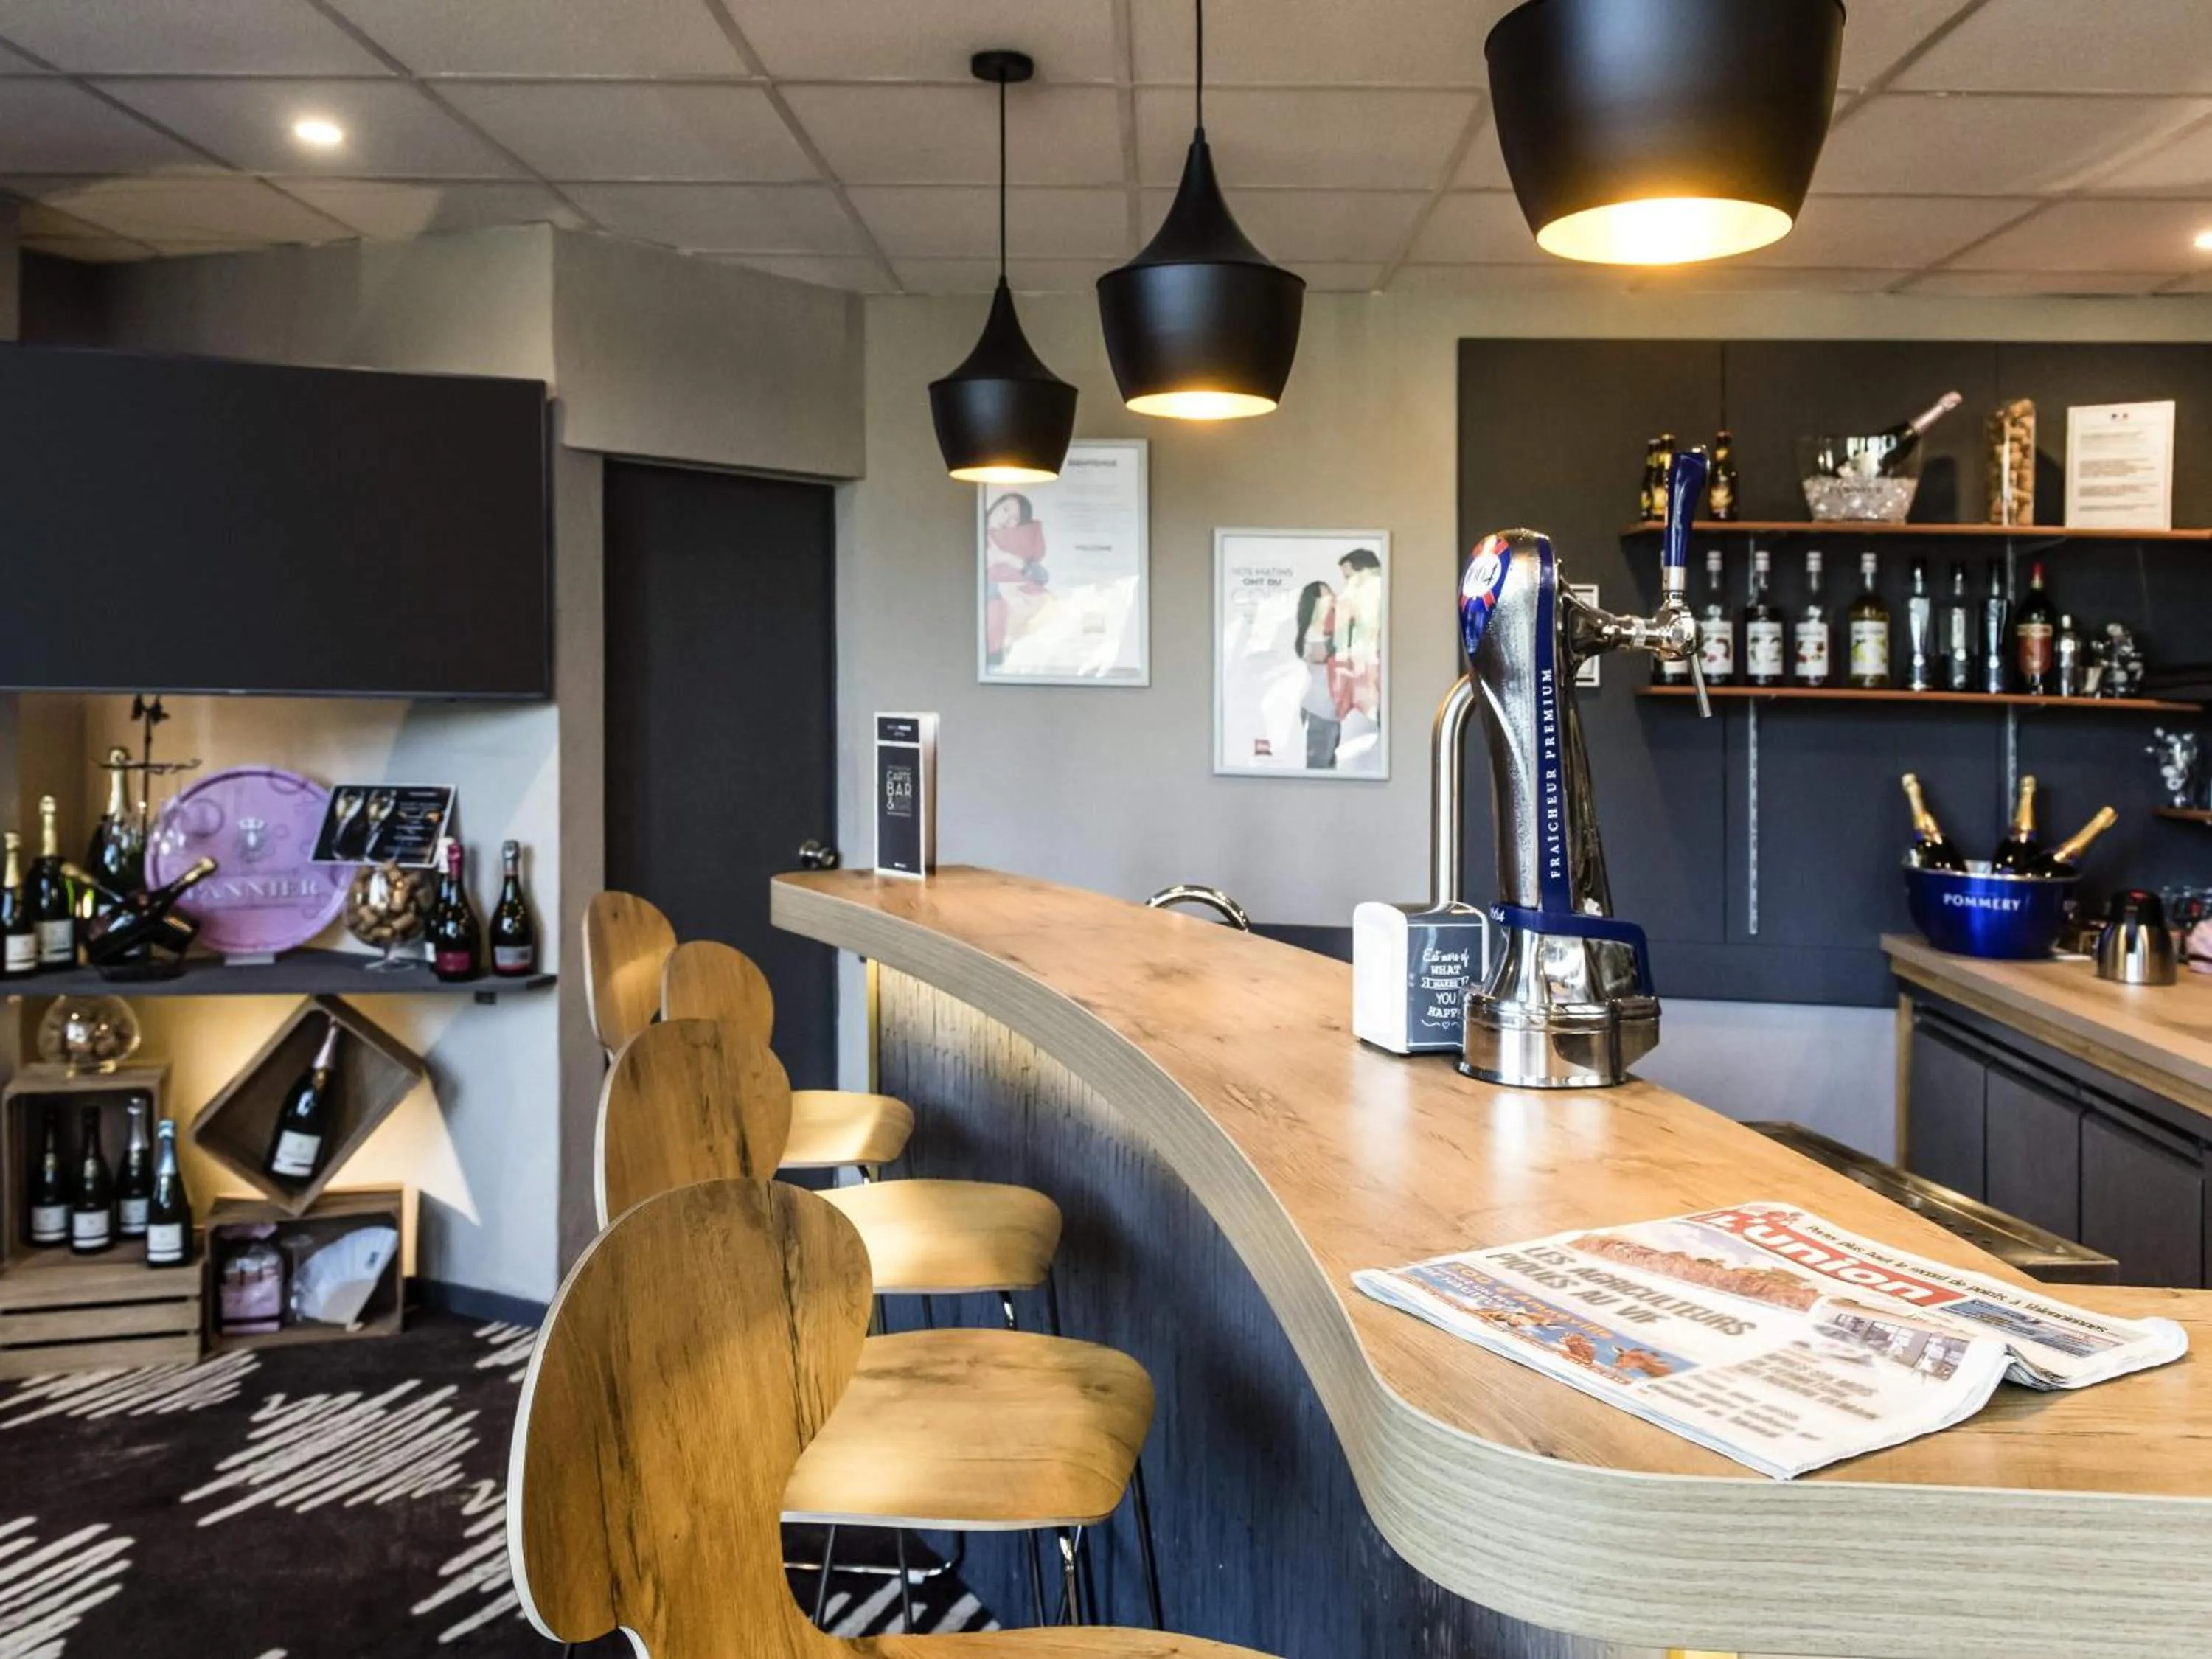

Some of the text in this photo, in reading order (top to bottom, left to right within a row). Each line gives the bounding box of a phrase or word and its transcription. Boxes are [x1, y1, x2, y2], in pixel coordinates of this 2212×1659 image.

[1541, 669, 1557, 759] PREMIUM
[886, 781, 913, 799] BAR
[1943, 892, 2020, 911] POMMERY
[1430, 964, 1462, 975] WHAT
[1436, 992, 1457, 1005] YOU
[1521, 1245, 1577, 1266] LES
[1565, 1267, 1757, 1336] AGRICULTEURS
[1568, 1290, 1623, 1306] AU
